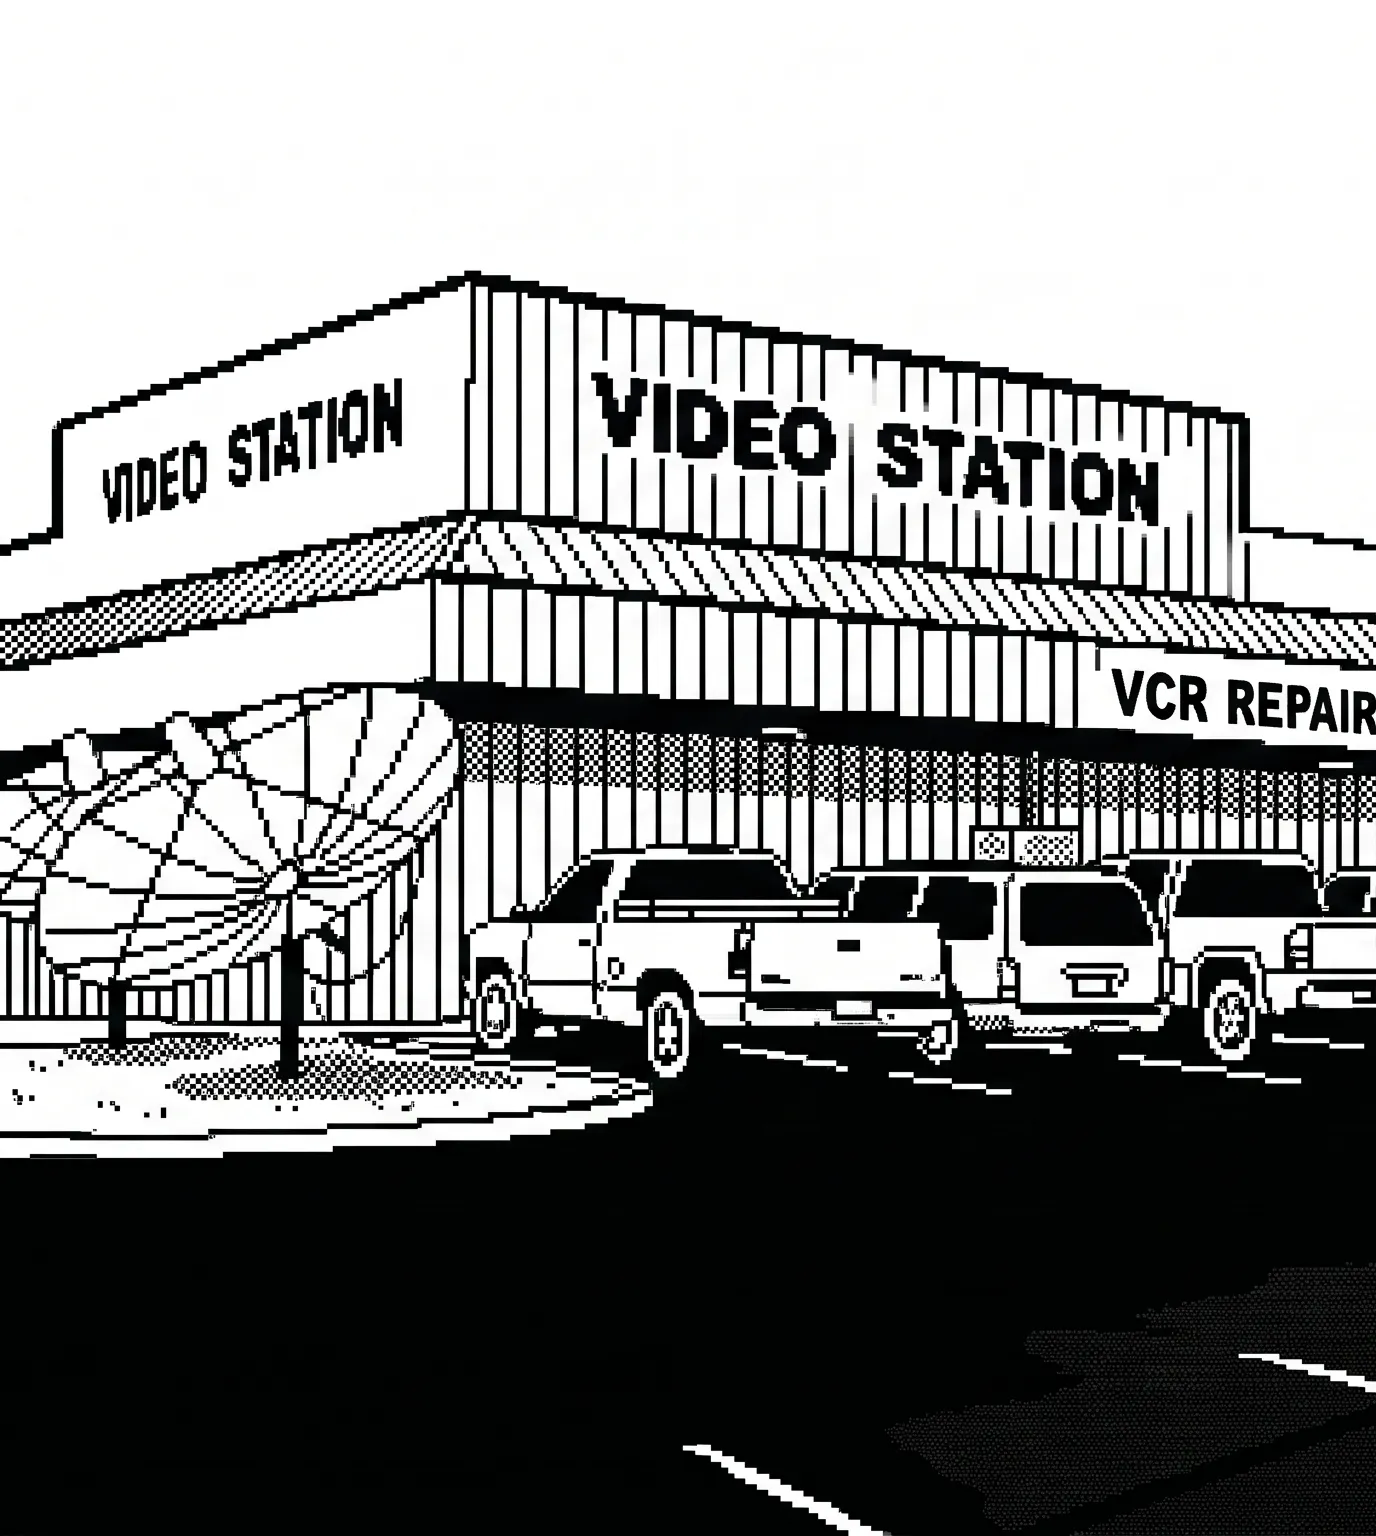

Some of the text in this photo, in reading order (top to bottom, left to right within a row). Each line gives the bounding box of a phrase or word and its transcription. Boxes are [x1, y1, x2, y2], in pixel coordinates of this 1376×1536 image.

[103, 378, 402, 524] VIDEO STATION
[591, 372, 1158, 526] VIDEO STATION
[1112, 669, 1208, 722] VCR
